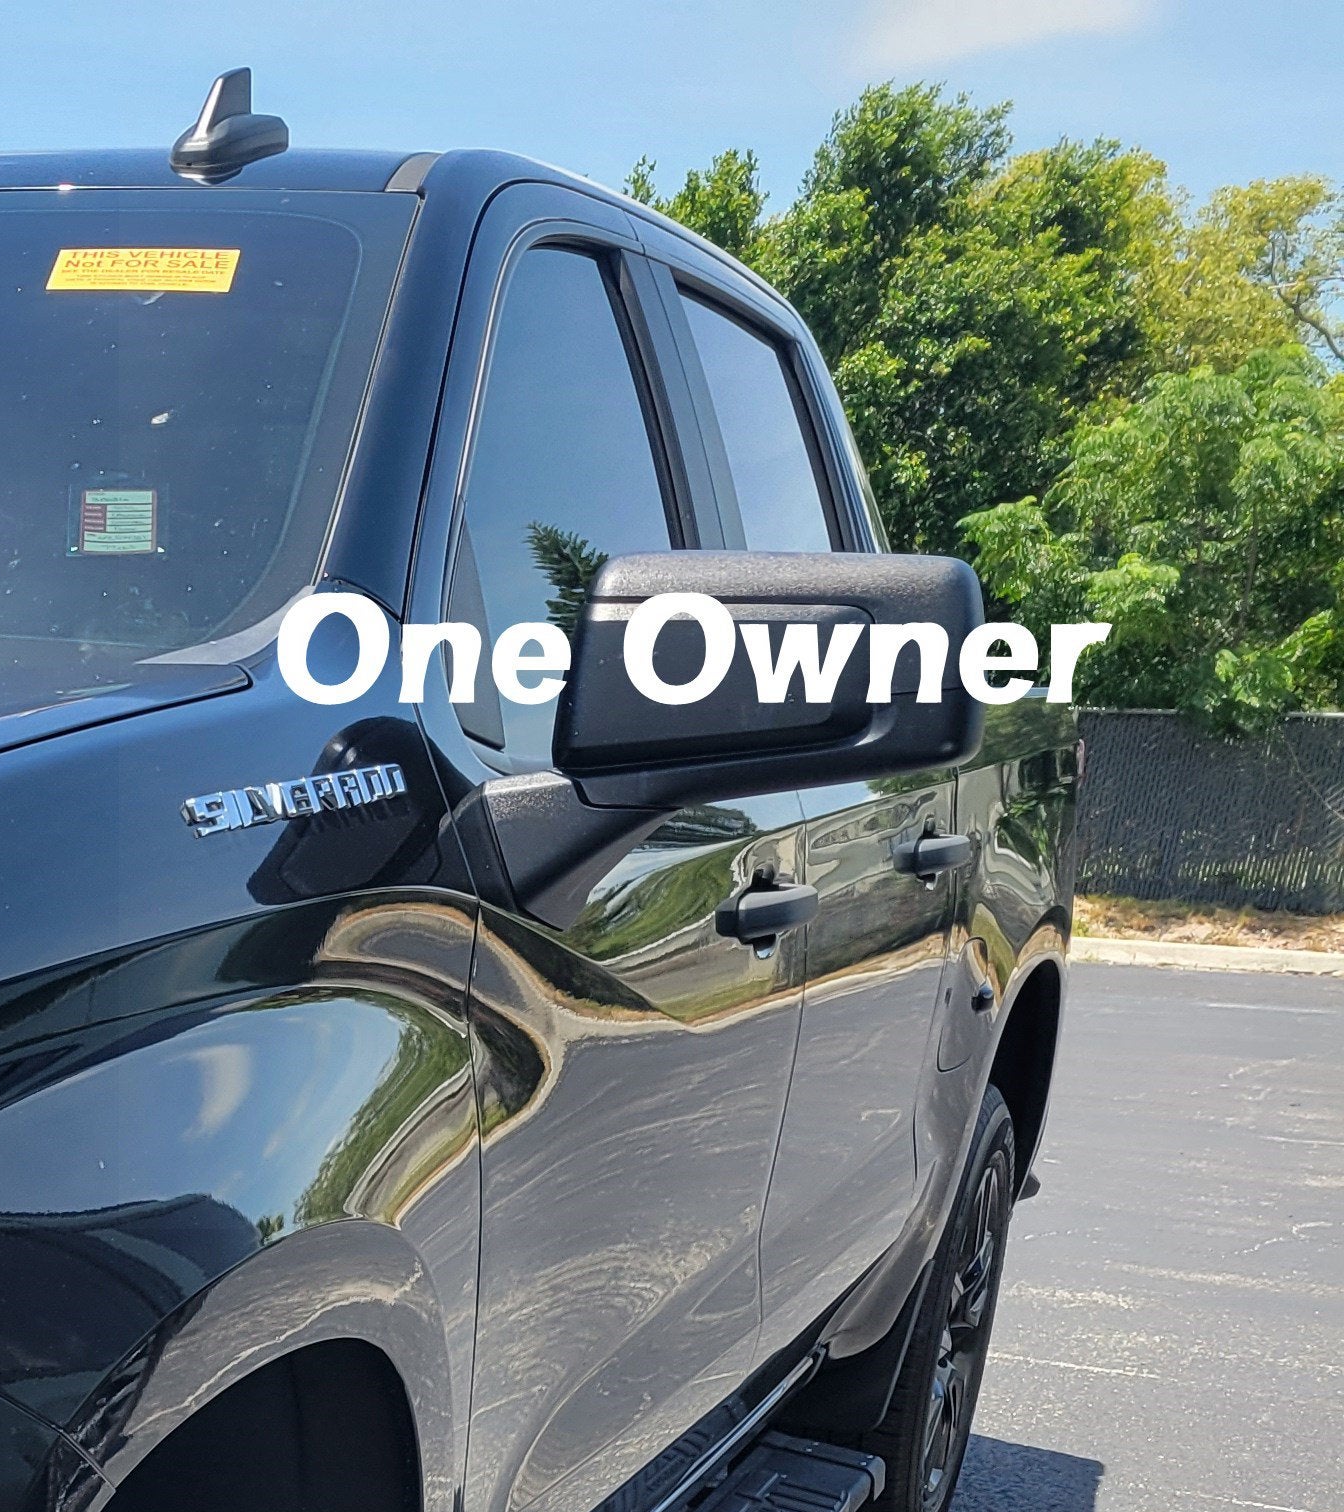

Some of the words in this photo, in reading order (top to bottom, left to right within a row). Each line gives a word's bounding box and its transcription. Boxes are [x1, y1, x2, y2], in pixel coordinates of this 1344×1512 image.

[70, 251, 120, 259] THIS
[129, 251, 229, 260] VEHICLE
[64, 260, 102, 268] Not
[110, 260, 159, 269] FOR
[165, 260, 230, 269] SALE
